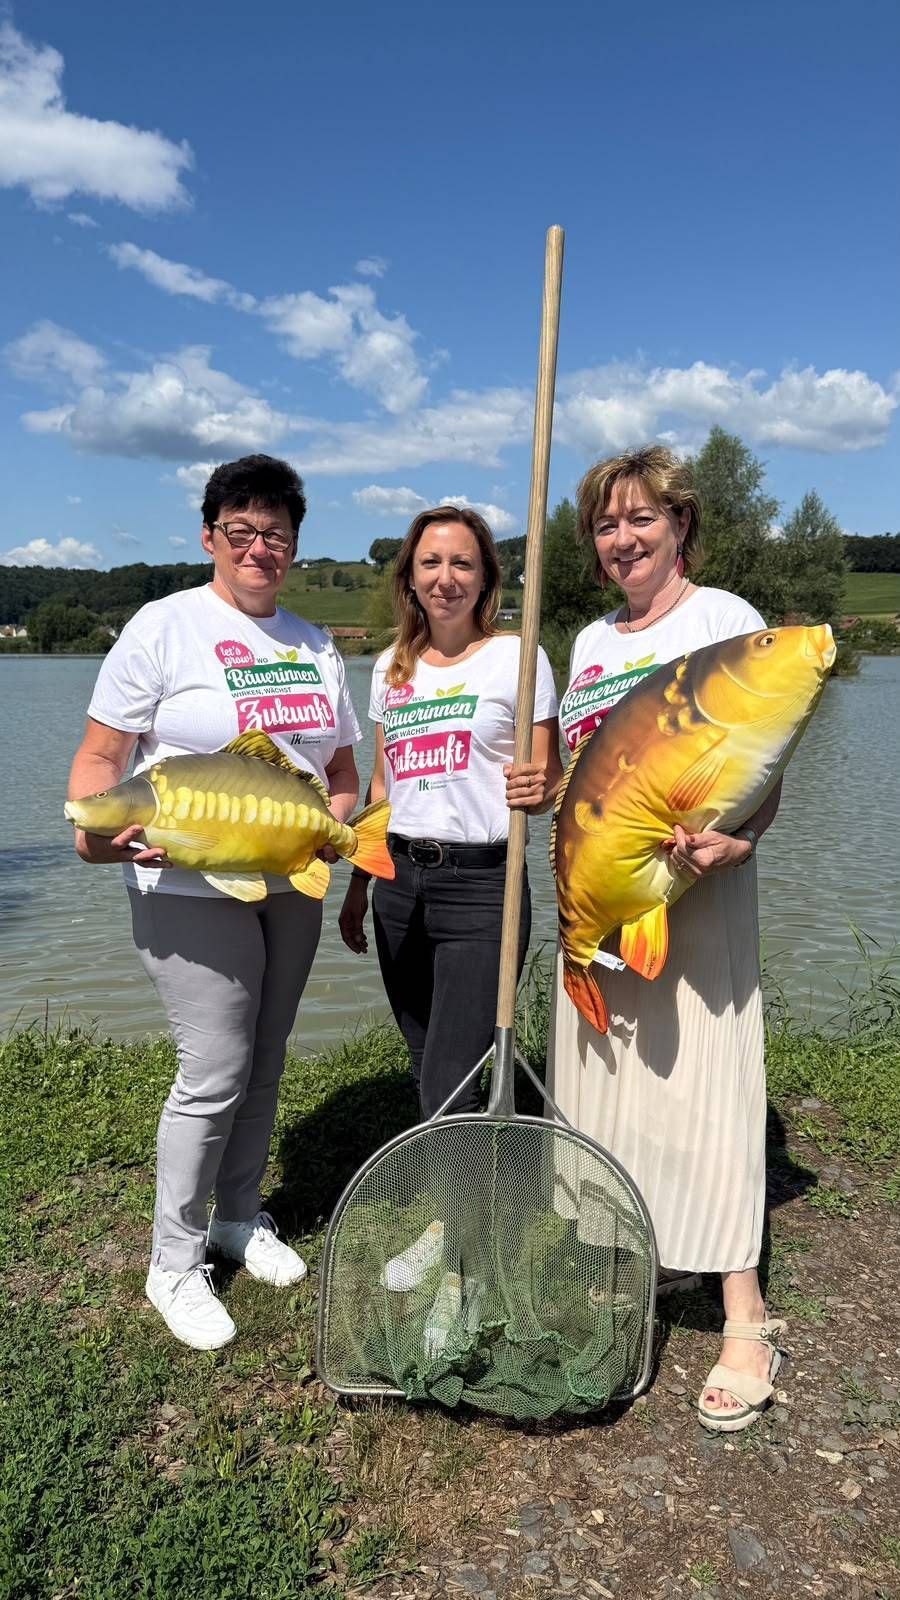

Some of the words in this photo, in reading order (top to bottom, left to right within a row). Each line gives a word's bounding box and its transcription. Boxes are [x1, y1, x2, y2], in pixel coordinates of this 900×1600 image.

[219, 646, 241, 656] let's
[224, 651, 254, 667] grow!
[226, 667, 319, 688] Bäuerinnen
[231, 688, 264, 699] WIRKEN,
[264, 686, 292, 696] WÄCHST
[239, 696, 332, 732] Zukunft
[384, 700, 473, 732] Bäuerinnen
[399, 726, 429, 737] WÄCHST
